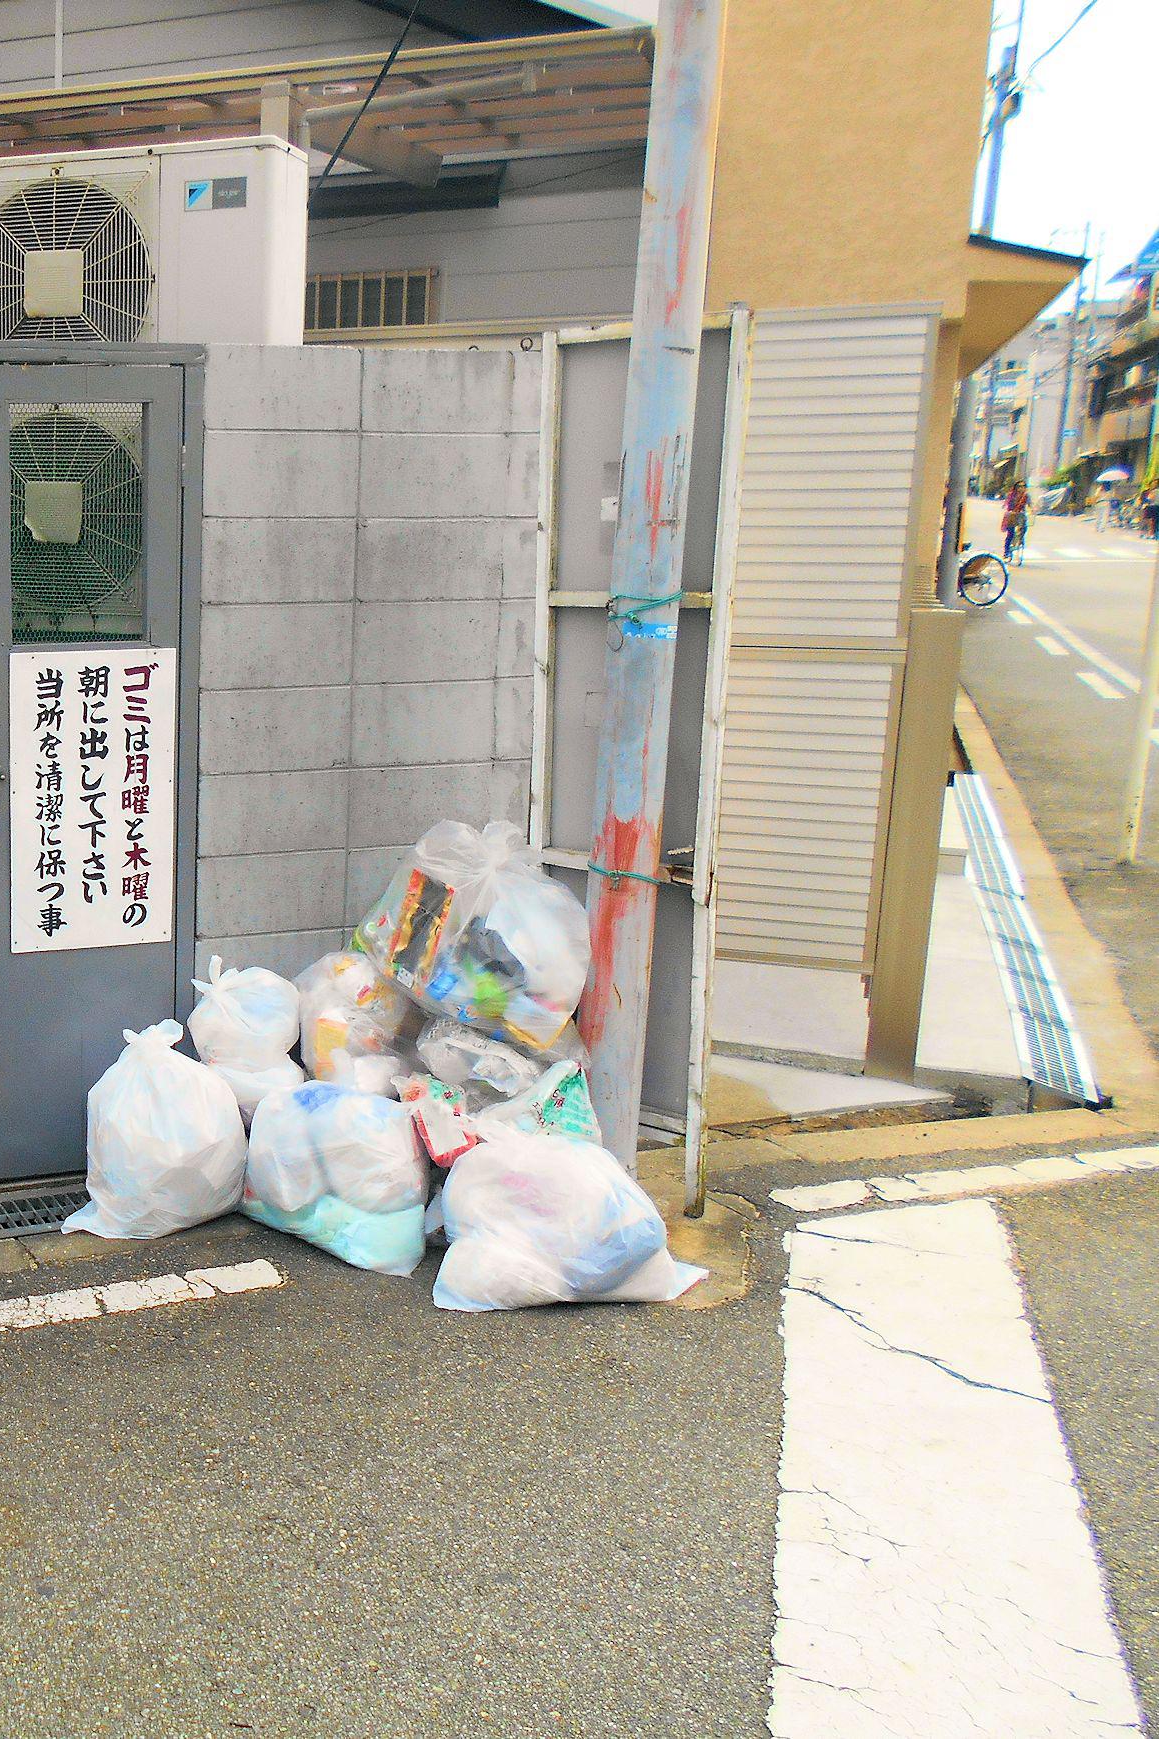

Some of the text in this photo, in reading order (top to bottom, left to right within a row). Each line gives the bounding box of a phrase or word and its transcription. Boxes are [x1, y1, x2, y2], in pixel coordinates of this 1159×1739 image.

[33, 667, 67, 937] 当所を清潔に保つ事
[77, 665, 110, 904] 朝に出して下さい
[122, 662, 159, 928] ゴミは月曜と木曜の
